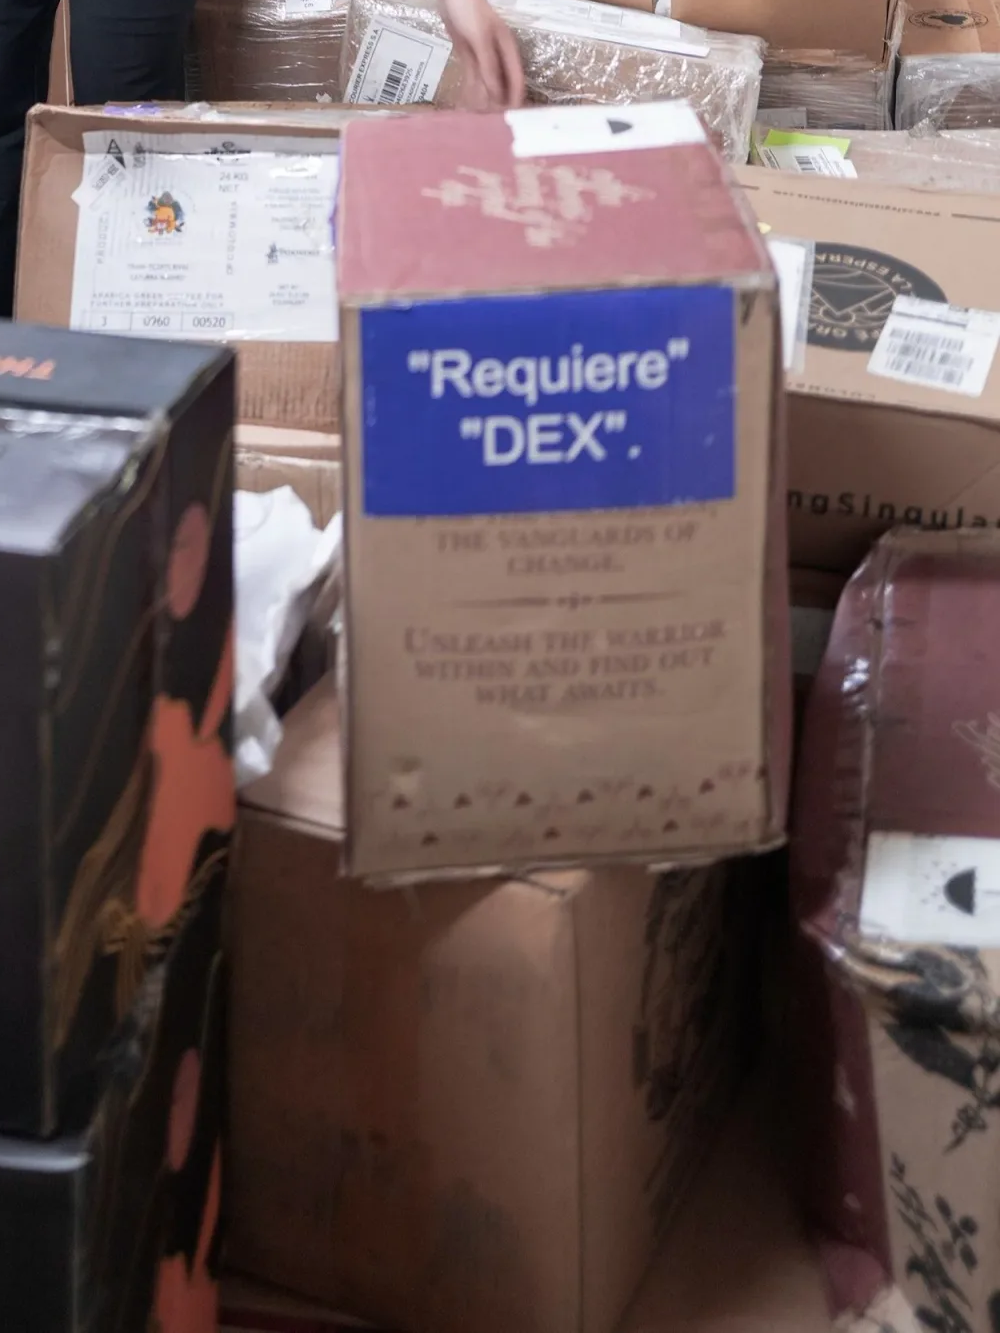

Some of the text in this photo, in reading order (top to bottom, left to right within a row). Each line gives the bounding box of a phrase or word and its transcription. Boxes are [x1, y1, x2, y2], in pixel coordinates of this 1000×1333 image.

[349, 73, 363, 104] COURIER
[358, 41, 374, 74] EXPRESS
[406, 82, 417, 103] STADOS
[815, 252, 890, 276] ESPERA
[408, 338, 690, 406] "Requiere"
[437, 528, 489, 554] THE
[664, 520, 701, 546] OF
[542, 630, 592, 652] THE
[605, 619, 727, 648] WARRIOR
[415, 646, 717, 681] WITHIN AND FIND OUT
[476, 685, 551, 707] WHAT
